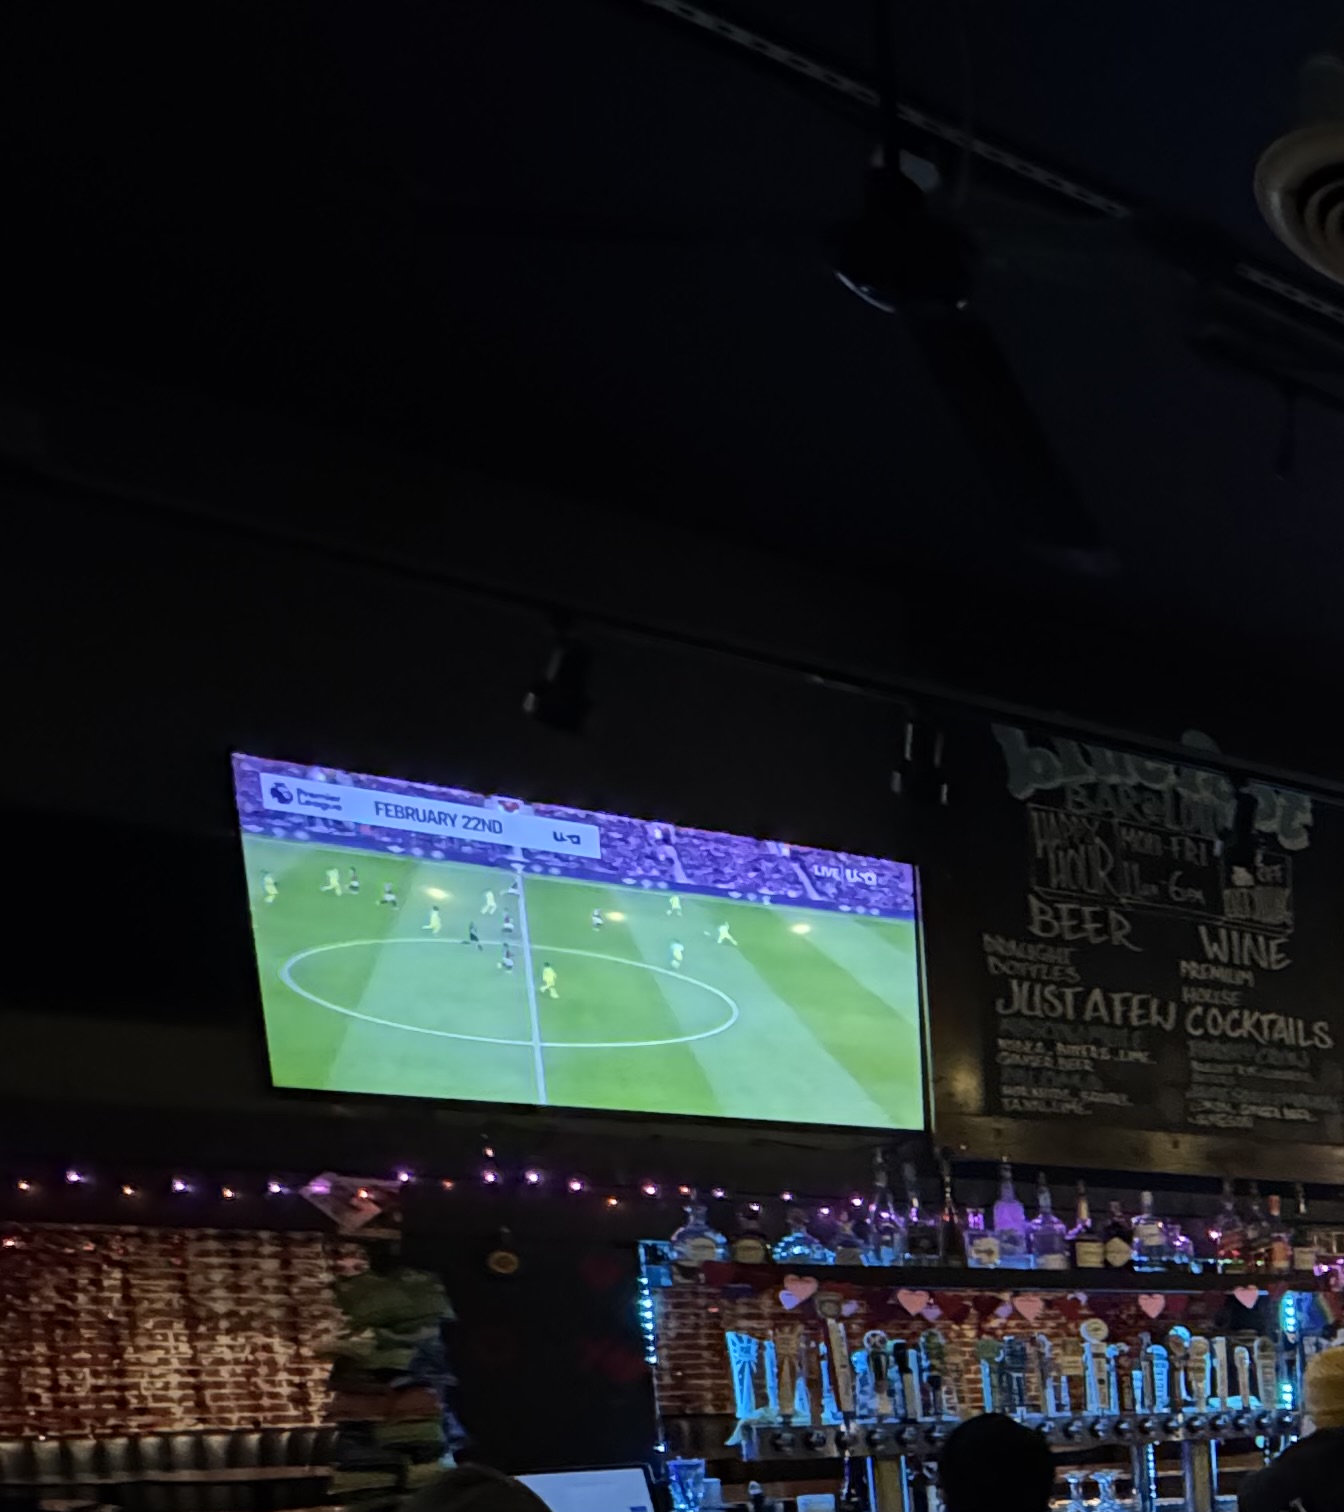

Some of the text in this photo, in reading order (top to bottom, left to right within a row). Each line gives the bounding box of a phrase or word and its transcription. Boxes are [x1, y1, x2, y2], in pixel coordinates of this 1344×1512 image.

[374, 800, 457, 828] FEBRUARY
[461, 814, 503, 835] 22ND
[1027, 893, 1145, 952] BEER
[1197, 924, 1295, 972] WINE
[995, 977, 1085, 1022] JUST
[1083, 986, 1111, 1025] A
[1107, 991, 1179, 1033] FEW
[1184, 1003, 1337, 1050] COCKTAILS
